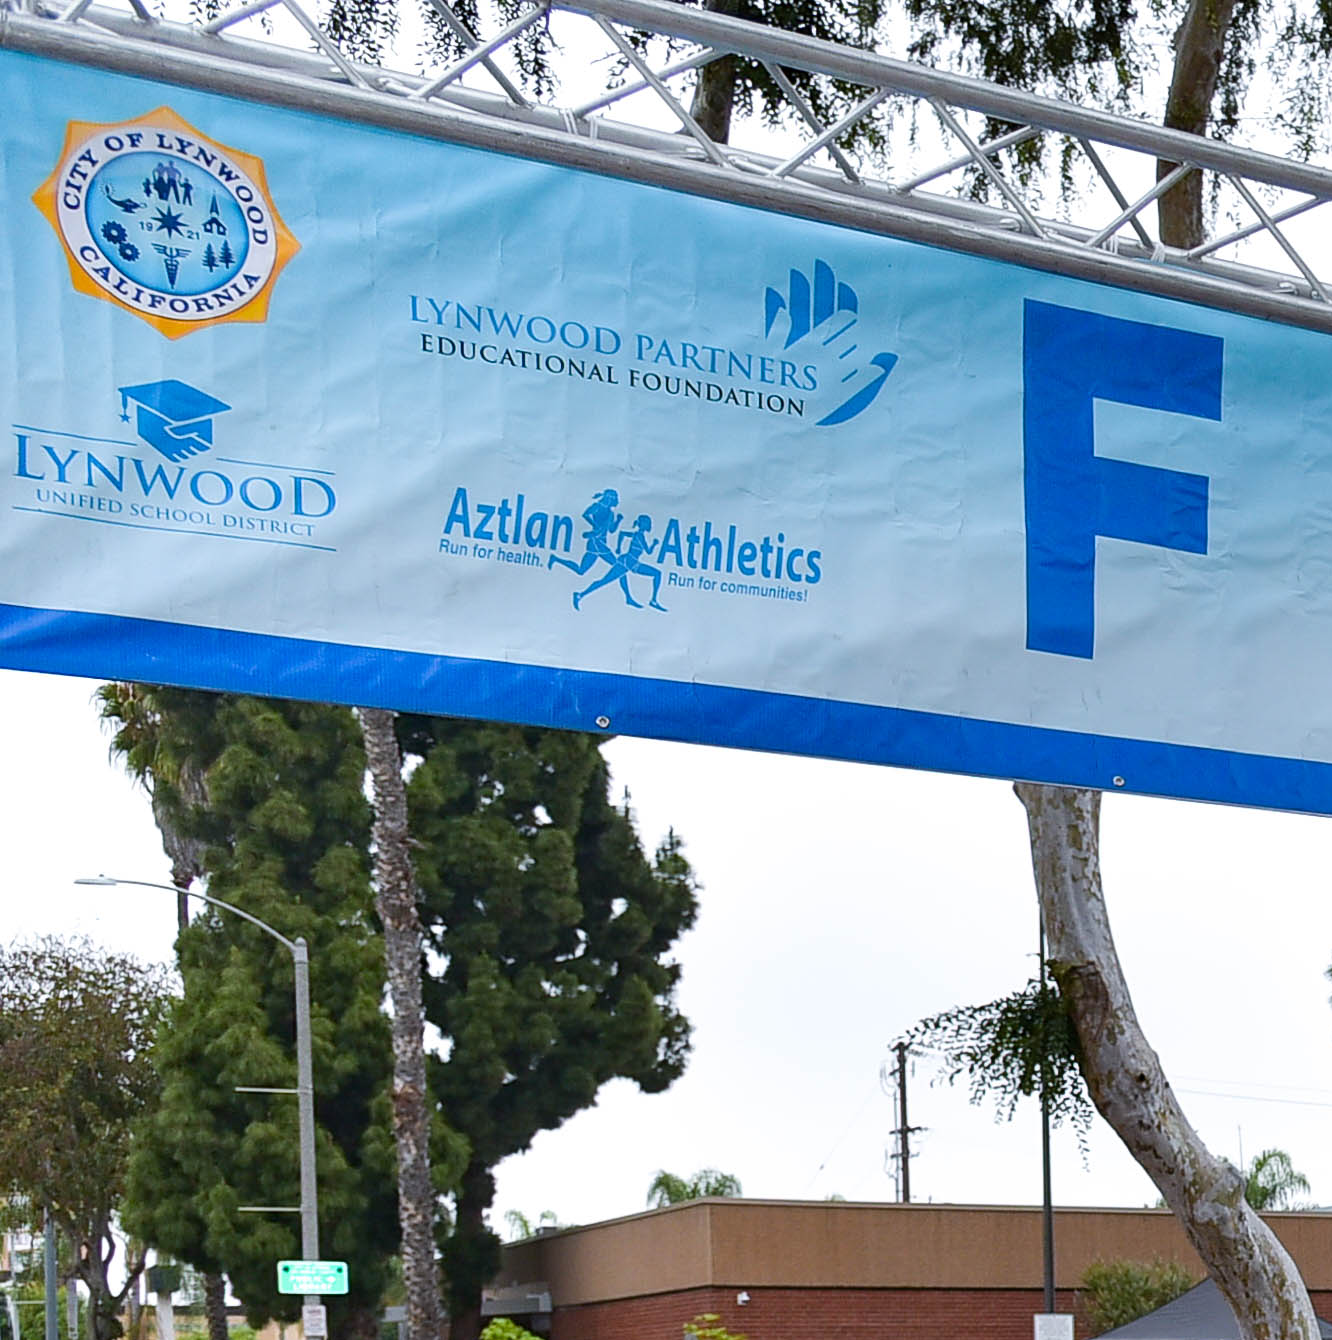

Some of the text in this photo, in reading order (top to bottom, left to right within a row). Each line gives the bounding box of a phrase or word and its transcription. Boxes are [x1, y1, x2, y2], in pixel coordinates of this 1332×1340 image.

[63, 133, 268, 245] CITY OF LYNWOOD
[139, 221, 200, 240] 19 21
[79, 245, 261, 313] CALIFORNIA
[407, 294, 818, 391] LYNWOOD PARTNERS
[421, 333, 805, 417] EDUCATIONAL FOUNDATION
[13, 433, 337, 518] LYNWOOD
[37, 487, 316, 538] UNIFIED SCHOOL DISTRICT
[443, 487, 573, 553] Aztlan
[439, 538, 544, 568] Run for health.
[657, 518, 823, 585] Athletics
[668, 572, 808, 602] Run for communities!
